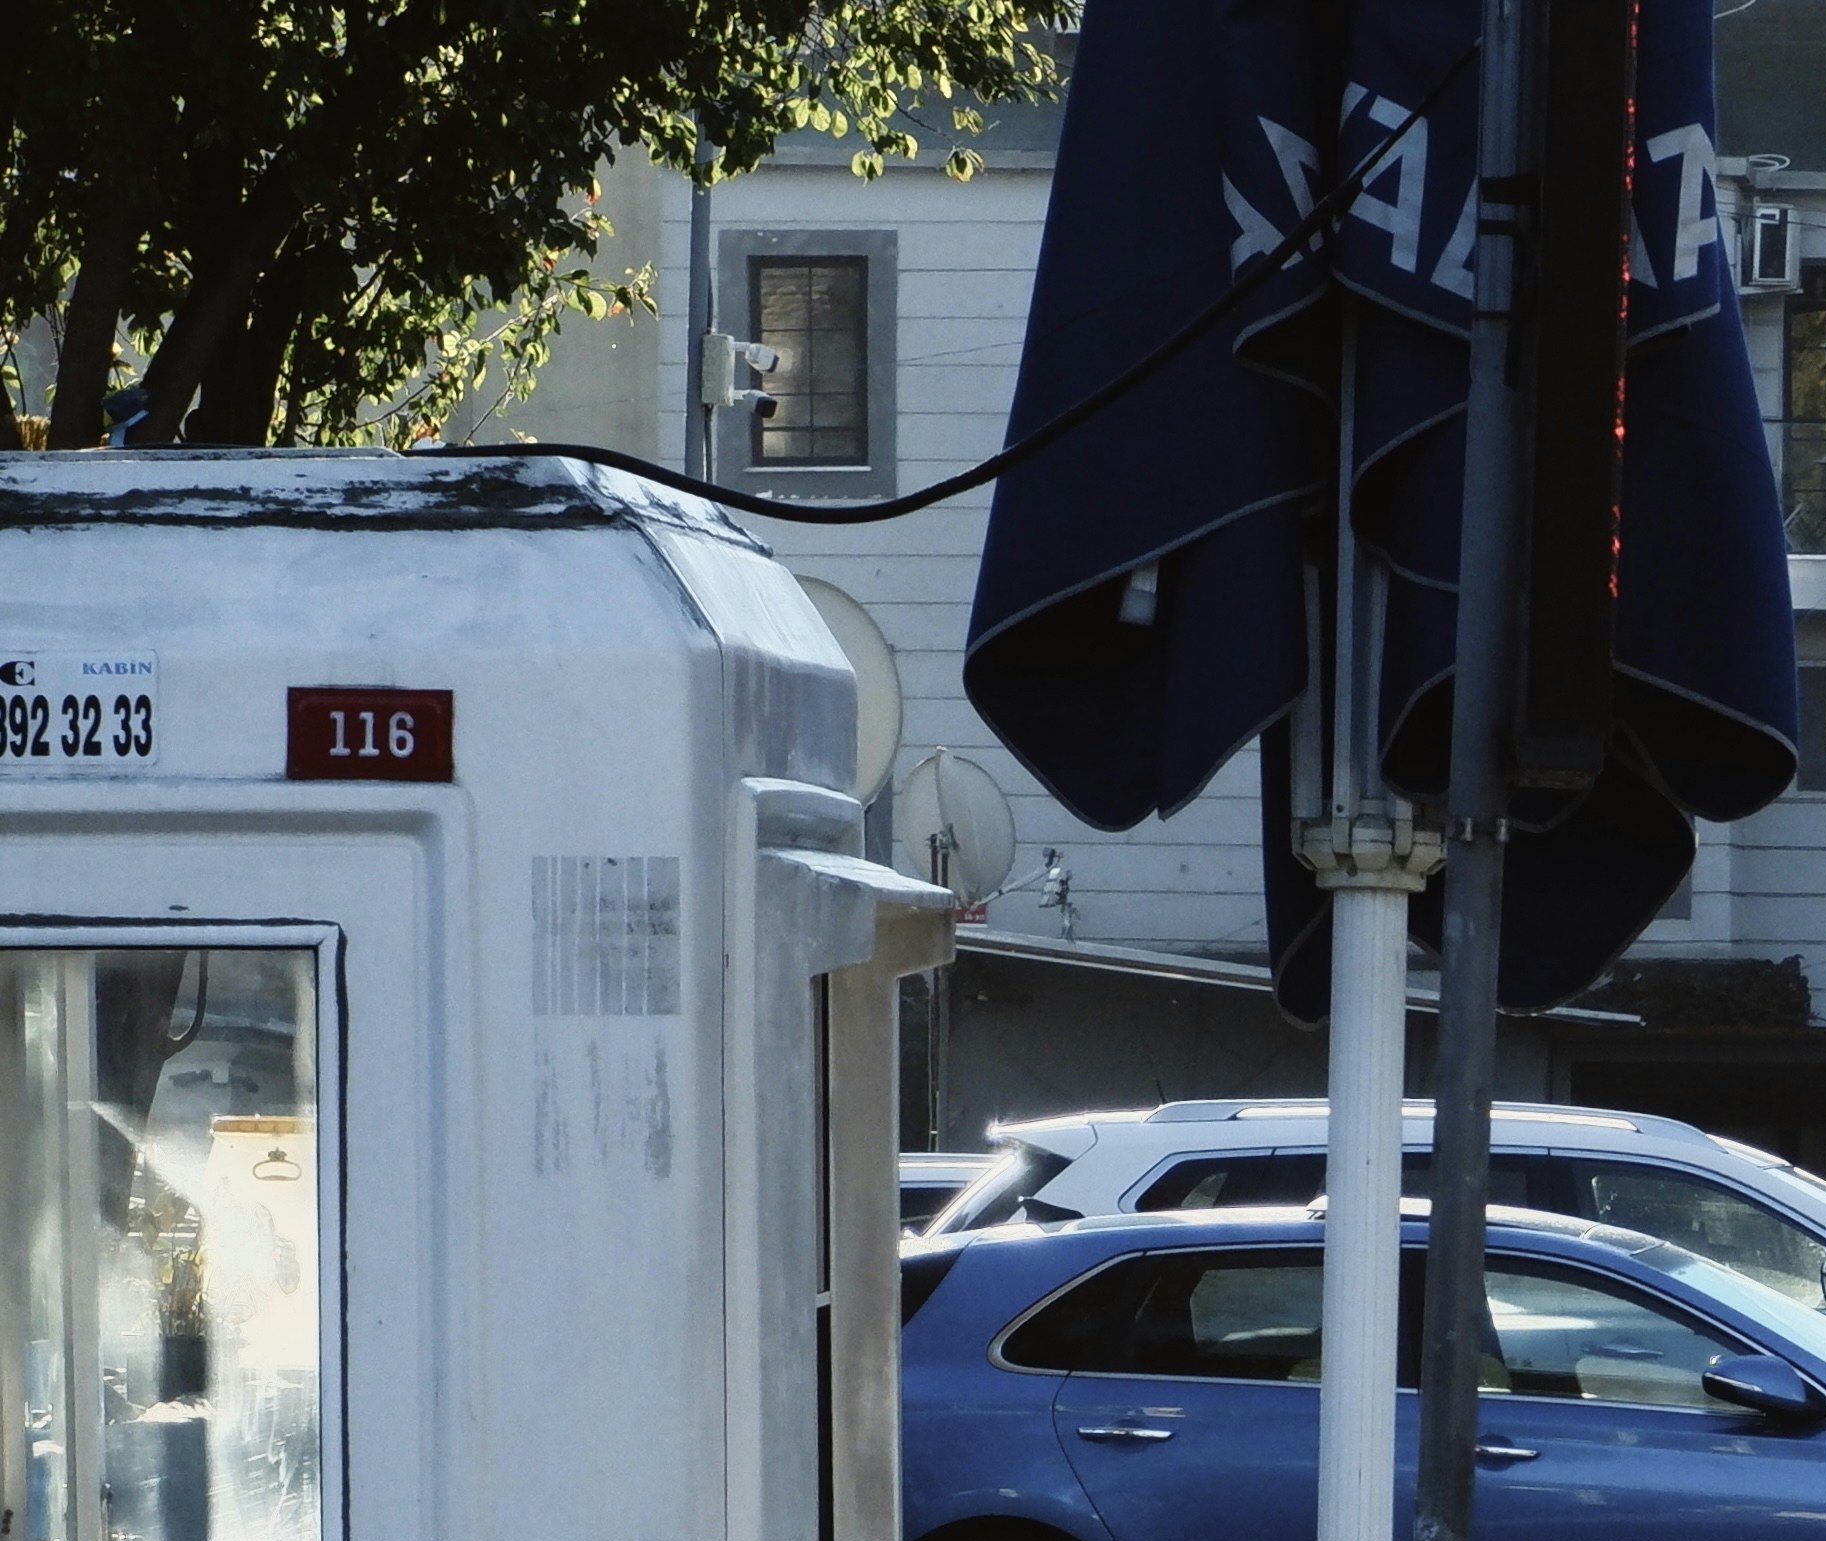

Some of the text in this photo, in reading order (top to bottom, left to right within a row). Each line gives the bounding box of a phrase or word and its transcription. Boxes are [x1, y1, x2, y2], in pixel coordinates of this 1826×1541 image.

[61, 694, 102, 758] 32
[113, 694, 152, 758] 33
[329, 710, 415, 759] 116
